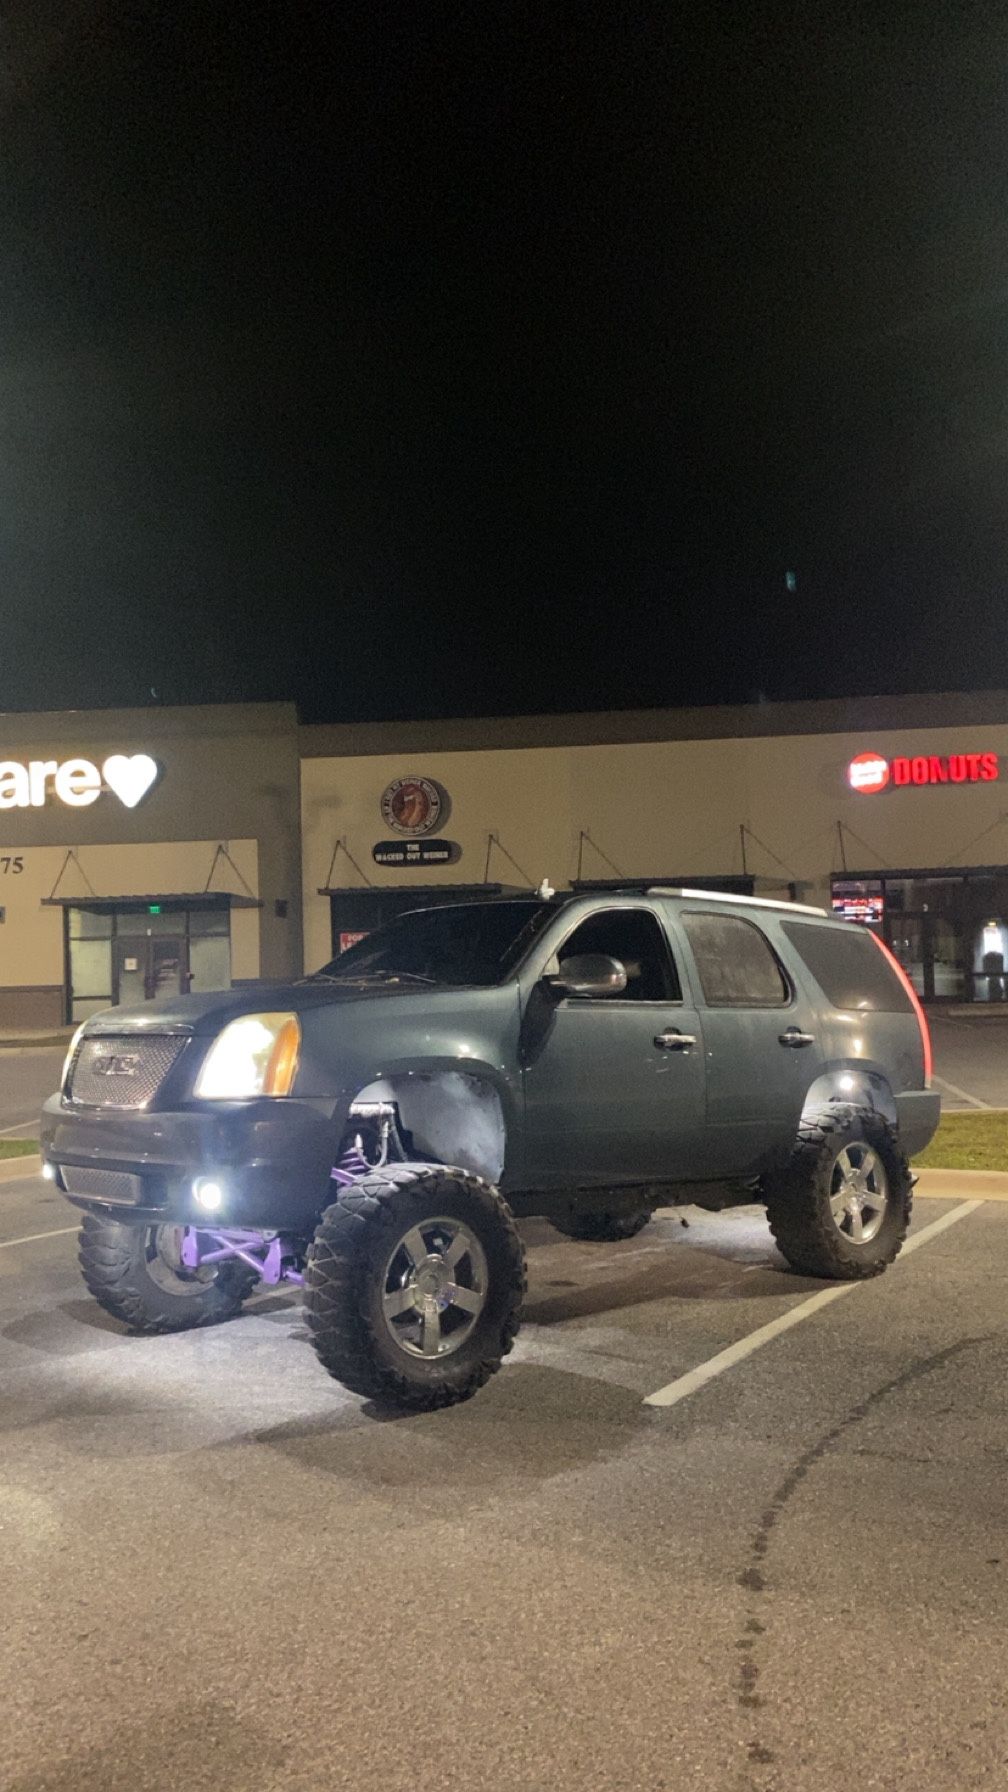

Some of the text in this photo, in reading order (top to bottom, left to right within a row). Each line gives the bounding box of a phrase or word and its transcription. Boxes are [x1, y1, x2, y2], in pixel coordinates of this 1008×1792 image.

[0, 759, 101, 809] are
[893, 752, 998, 785] DONUTS
[0, 857, 24, 874] 75
